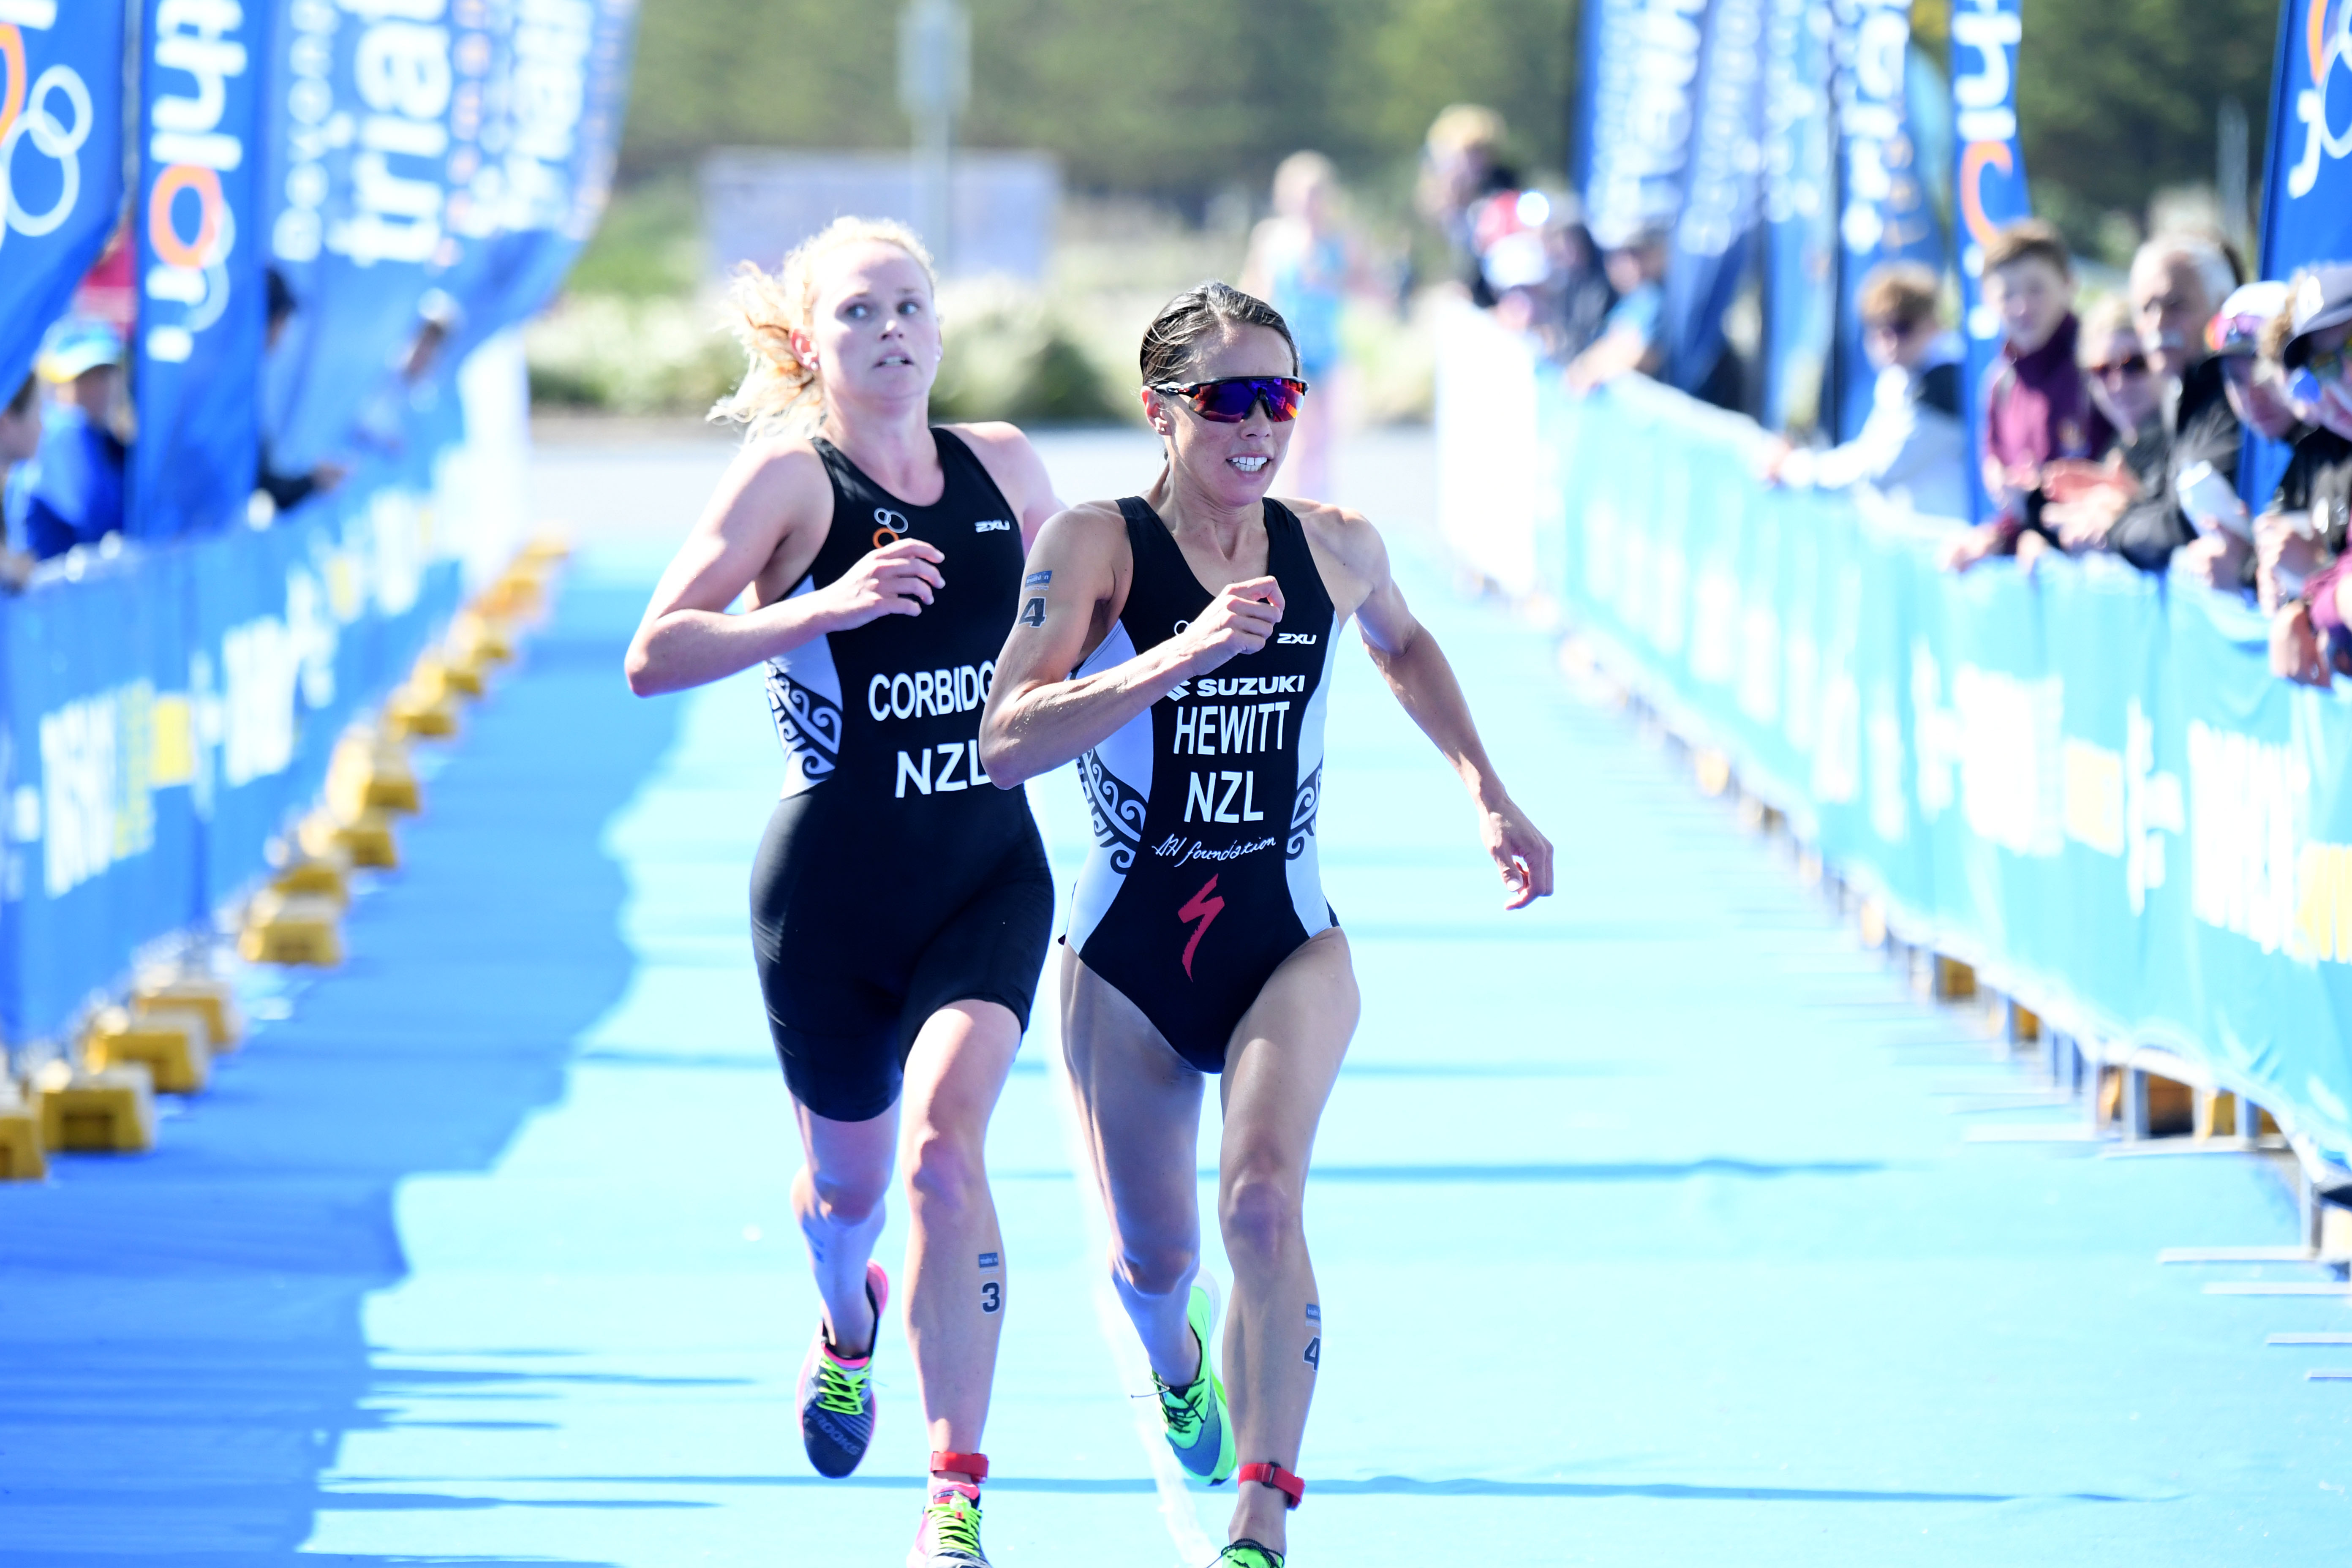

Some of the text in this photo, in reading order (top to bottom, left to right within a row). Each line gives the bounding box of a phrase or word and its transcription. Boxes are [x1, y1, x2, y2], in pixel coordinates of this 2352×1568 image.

[974, 519, 1010, 533] 2XU
[1018, 596, 1047, 628] 4
[1277, 633, 1317, 645] 2XU
[868, 660, 996, 721] CORBIDG
[1197, 675, 1305, 697] SUZUKI
[1173, 701, 1290, 755] HEWITT
[894, 739, 992, 798] NZL
[1184, 770, 1264, 823] NZL
[1173, 836, 1276, 868] foundation
[981, 1281, 1001, 1313] 3
[1303, 1337, 1321, 1371] 4
